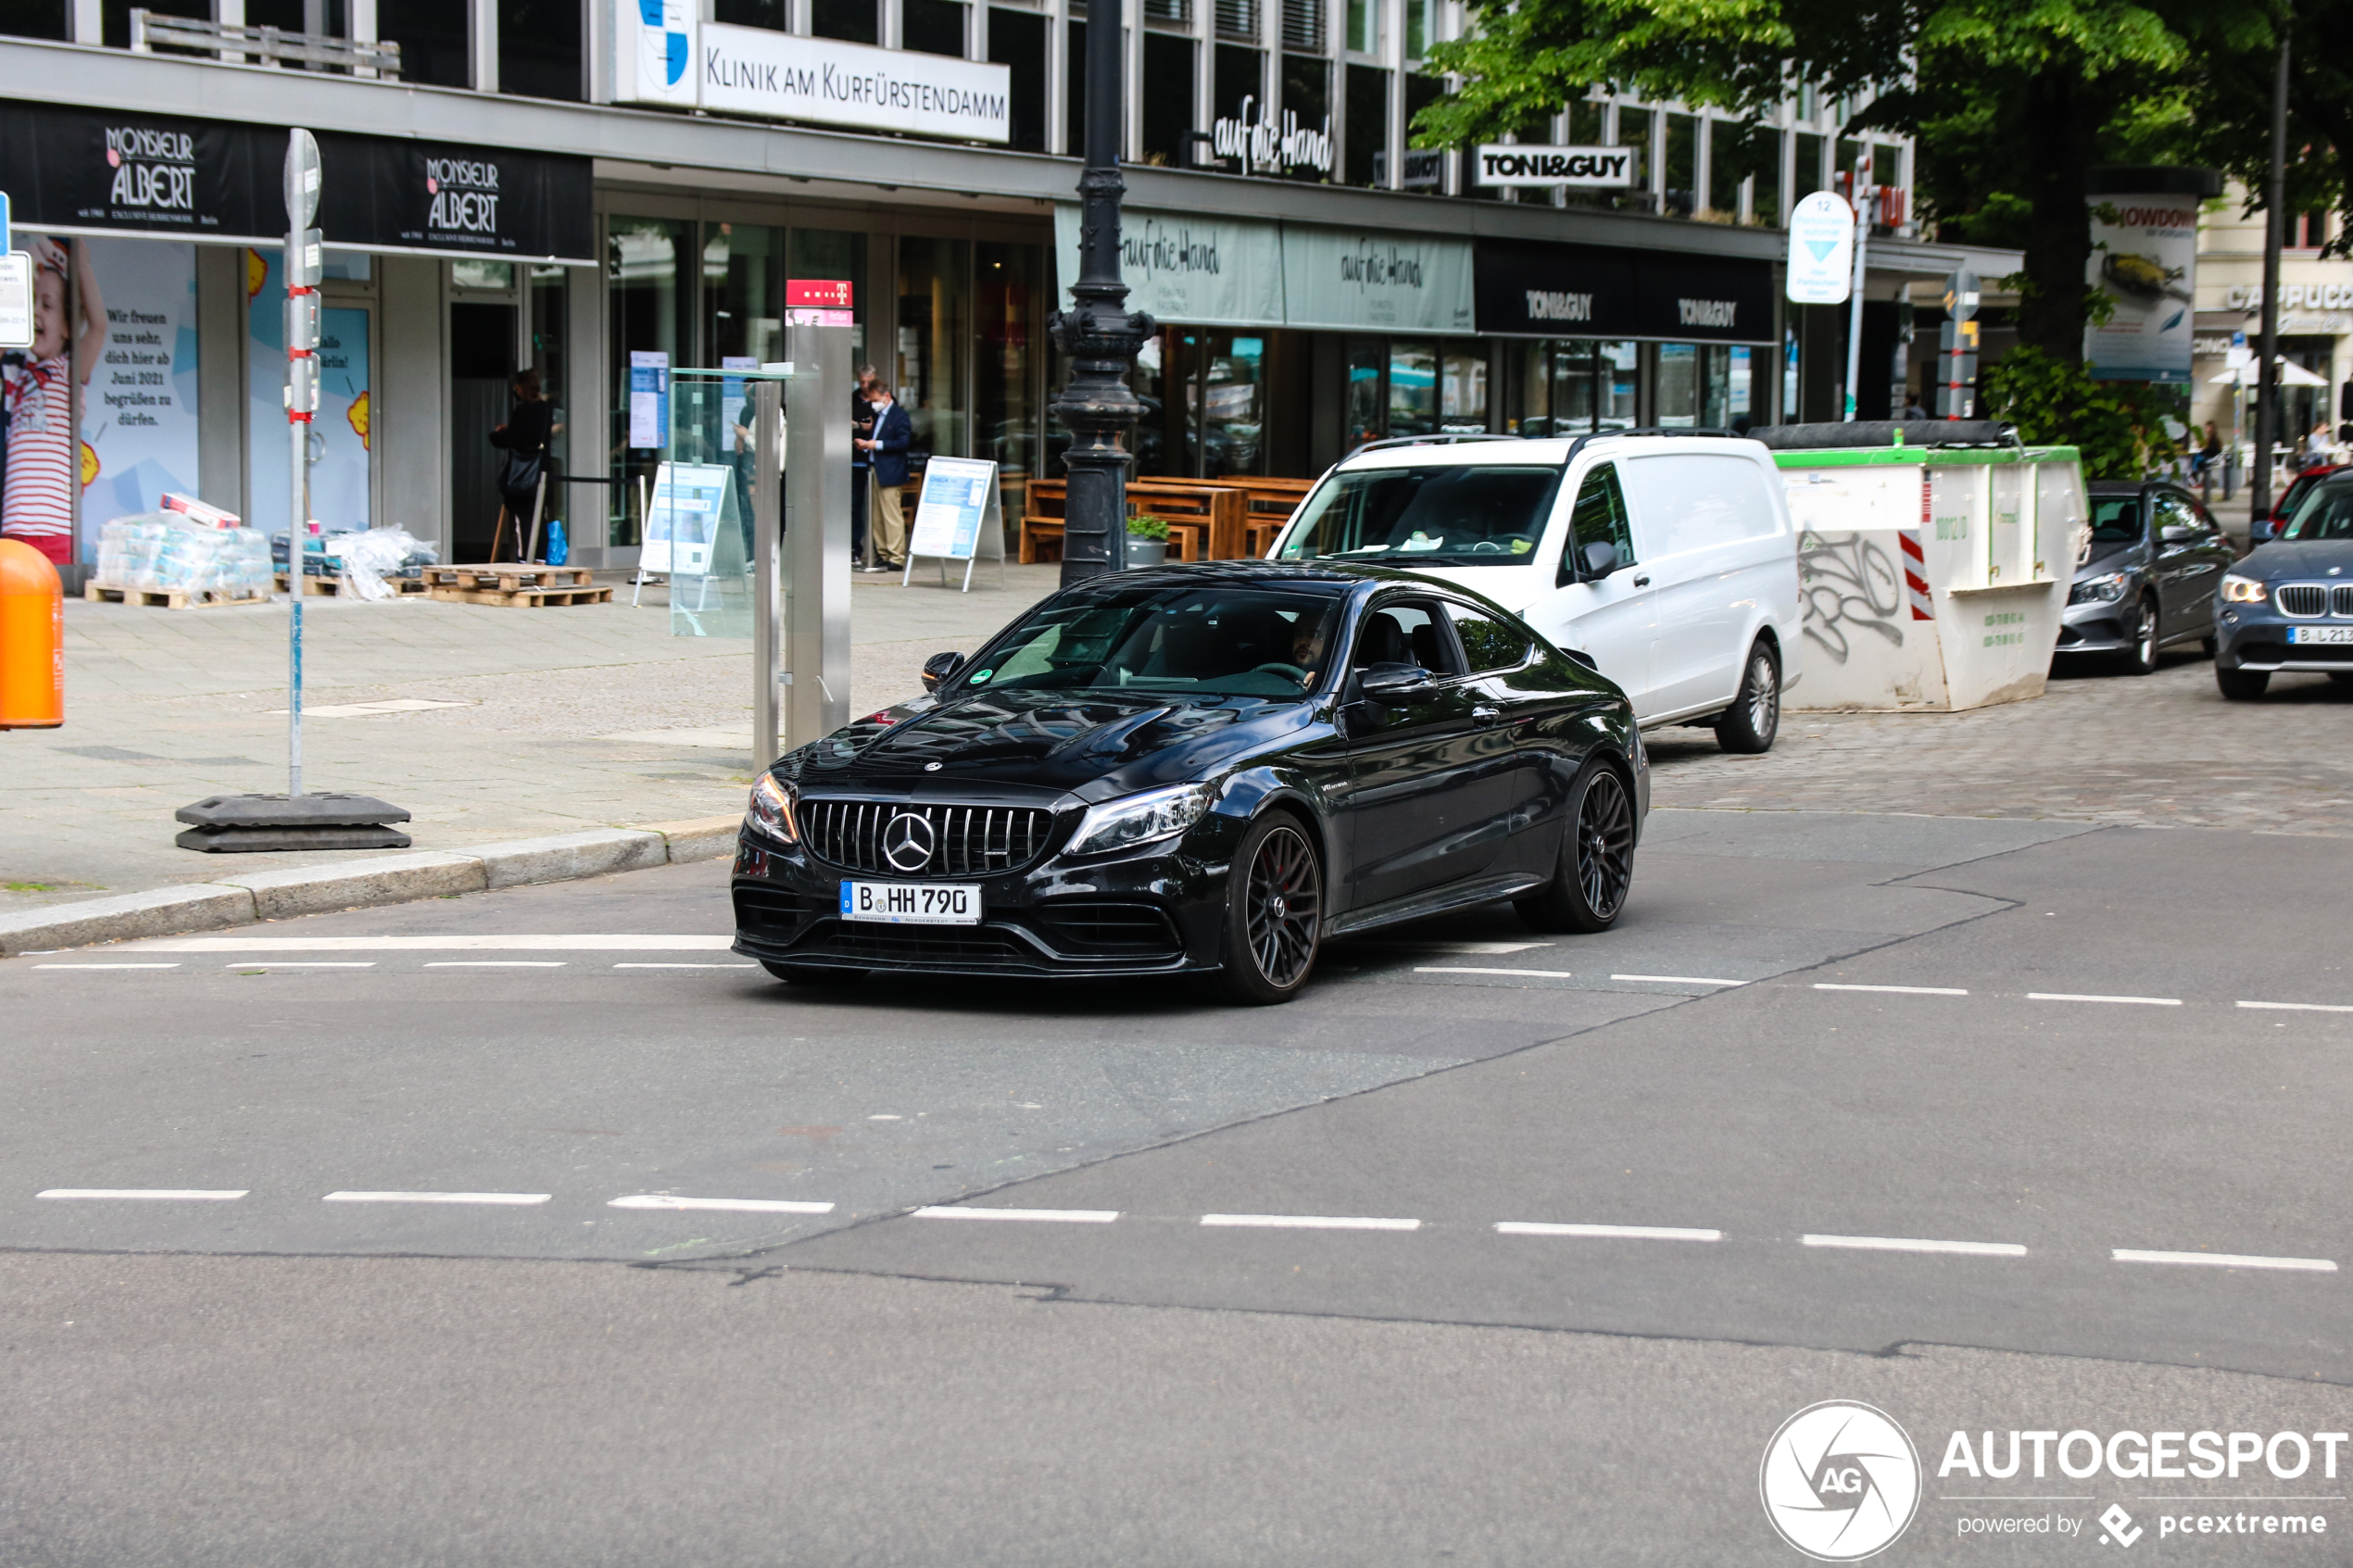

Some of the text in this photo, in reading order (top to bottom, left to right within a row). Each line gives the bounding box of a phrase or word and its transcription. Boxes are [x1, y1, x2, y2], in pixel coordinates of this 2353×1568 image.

[707, 45, 1005, 120] KLINIK AM KURFÜRSTENDAMM
[105, 126, 195, 161] MONSIEUR
[1214, 94, 1333, 176] auf die Hand
[426, 157, 499, 189] MONSIEUR
[1482, 154, 1629, 178] TONI&GUY
[110, 162, 196, 210] ALBERT
[428, 190, 499, 233] ALBERT
[1816, 200, 1831, 212] 12
[1123, 218, 1221, 281] auf die Hand
[1341, 237, 1424, 295] auf die Hand
[1796, 278, 1840, 286] Parkschein
[106, 308, 167, 325] Wir freuen
[1526, 290, 1593, 321] TONI&GUY
[1678, 298, 1737, 328] TONI&GUY
[112, 331, 162, 346] uns sehr,
[105, 350, 170, 365] dich hier ab
[111, 371, 164, 385] Juni 2021
[104, 391, 171, 408] begrüßen zu
[118, 412, 158, 426] dürfen.
[2301, 629, 2309, 641] B
[2318, 630, 2326, 642] L
[860, 886, 967, 914] B HH 790
